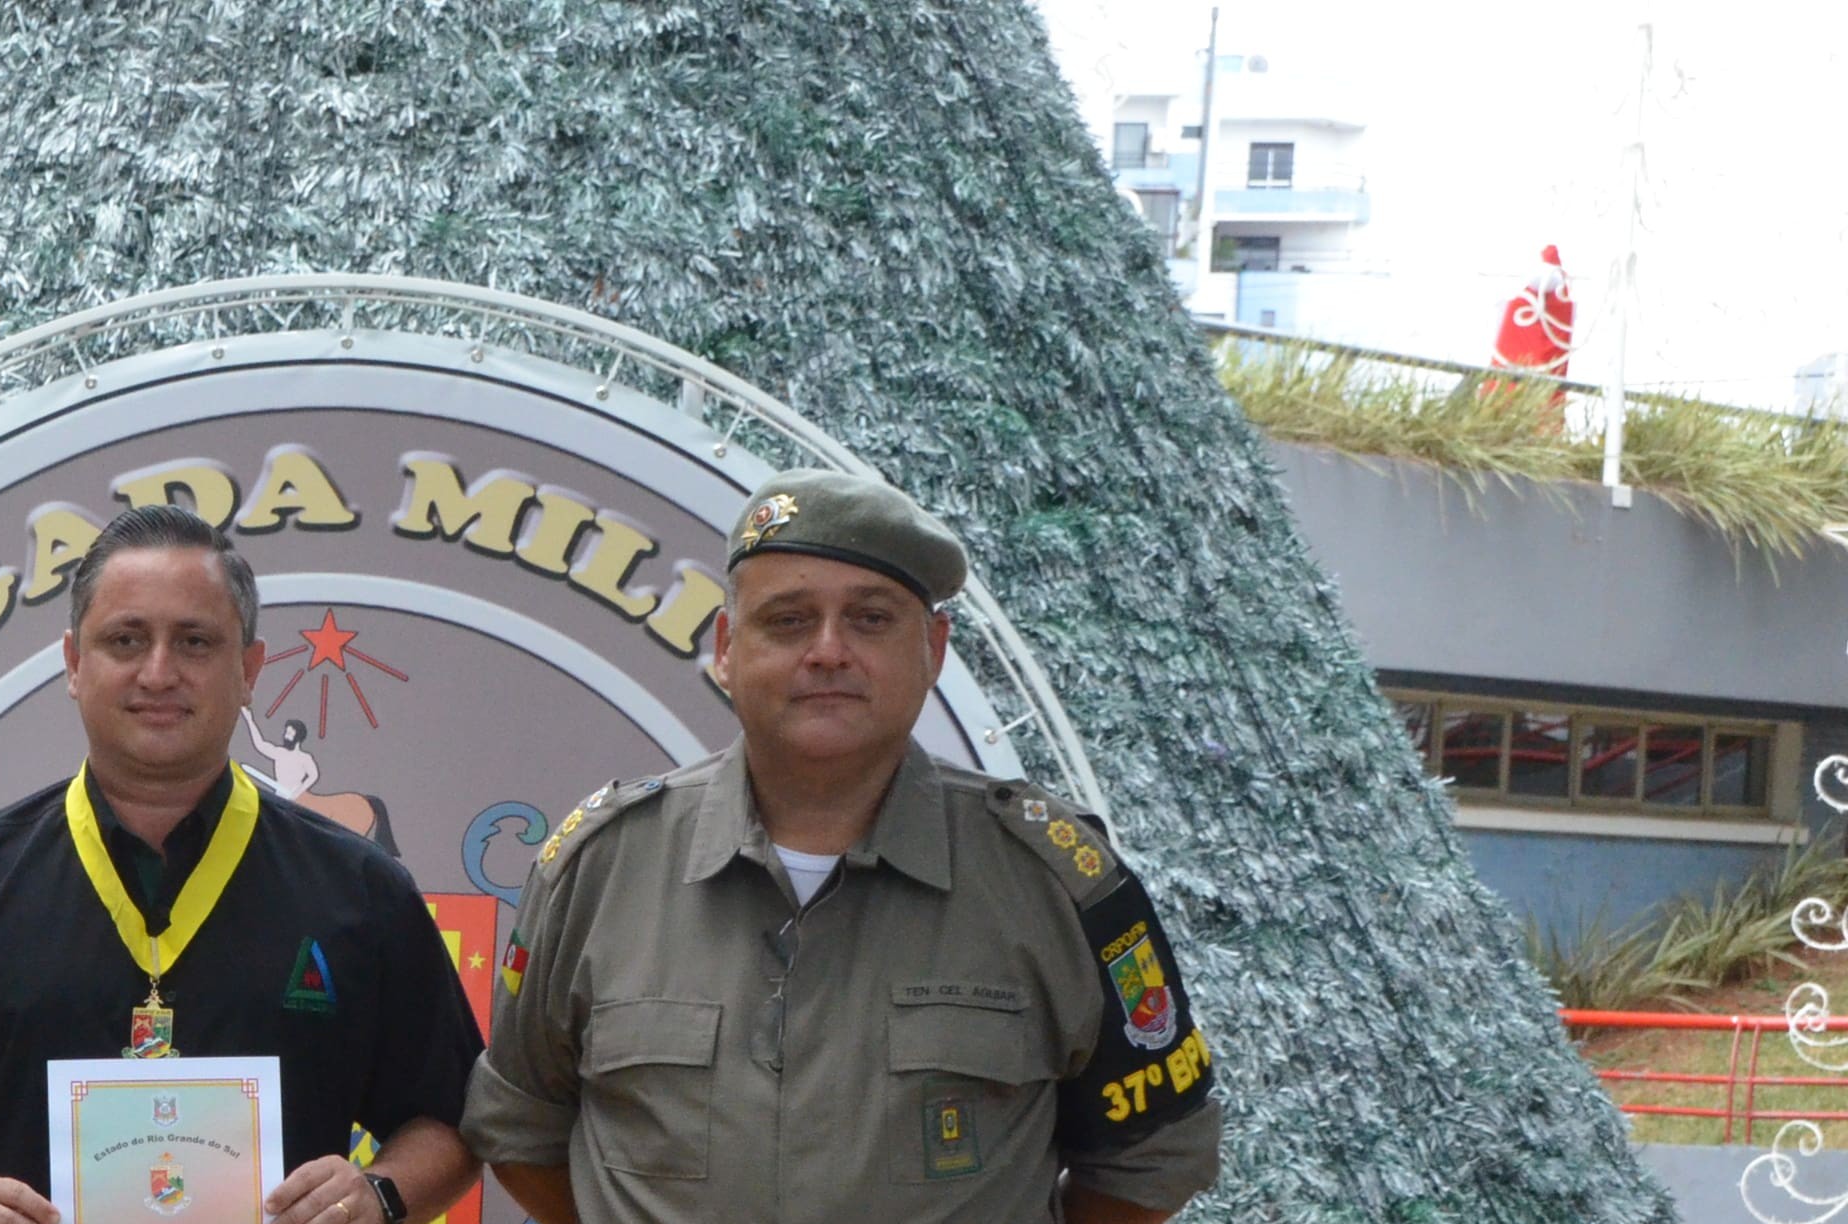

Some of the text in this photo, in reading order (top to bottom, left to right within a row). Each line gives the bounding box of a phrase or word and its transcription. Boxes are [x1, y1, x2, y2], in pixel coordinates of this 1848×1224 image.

[392, 457, 734, 698] MILI
[93, 1133, 241, 1162] Estado do Rio Grande do Sul
